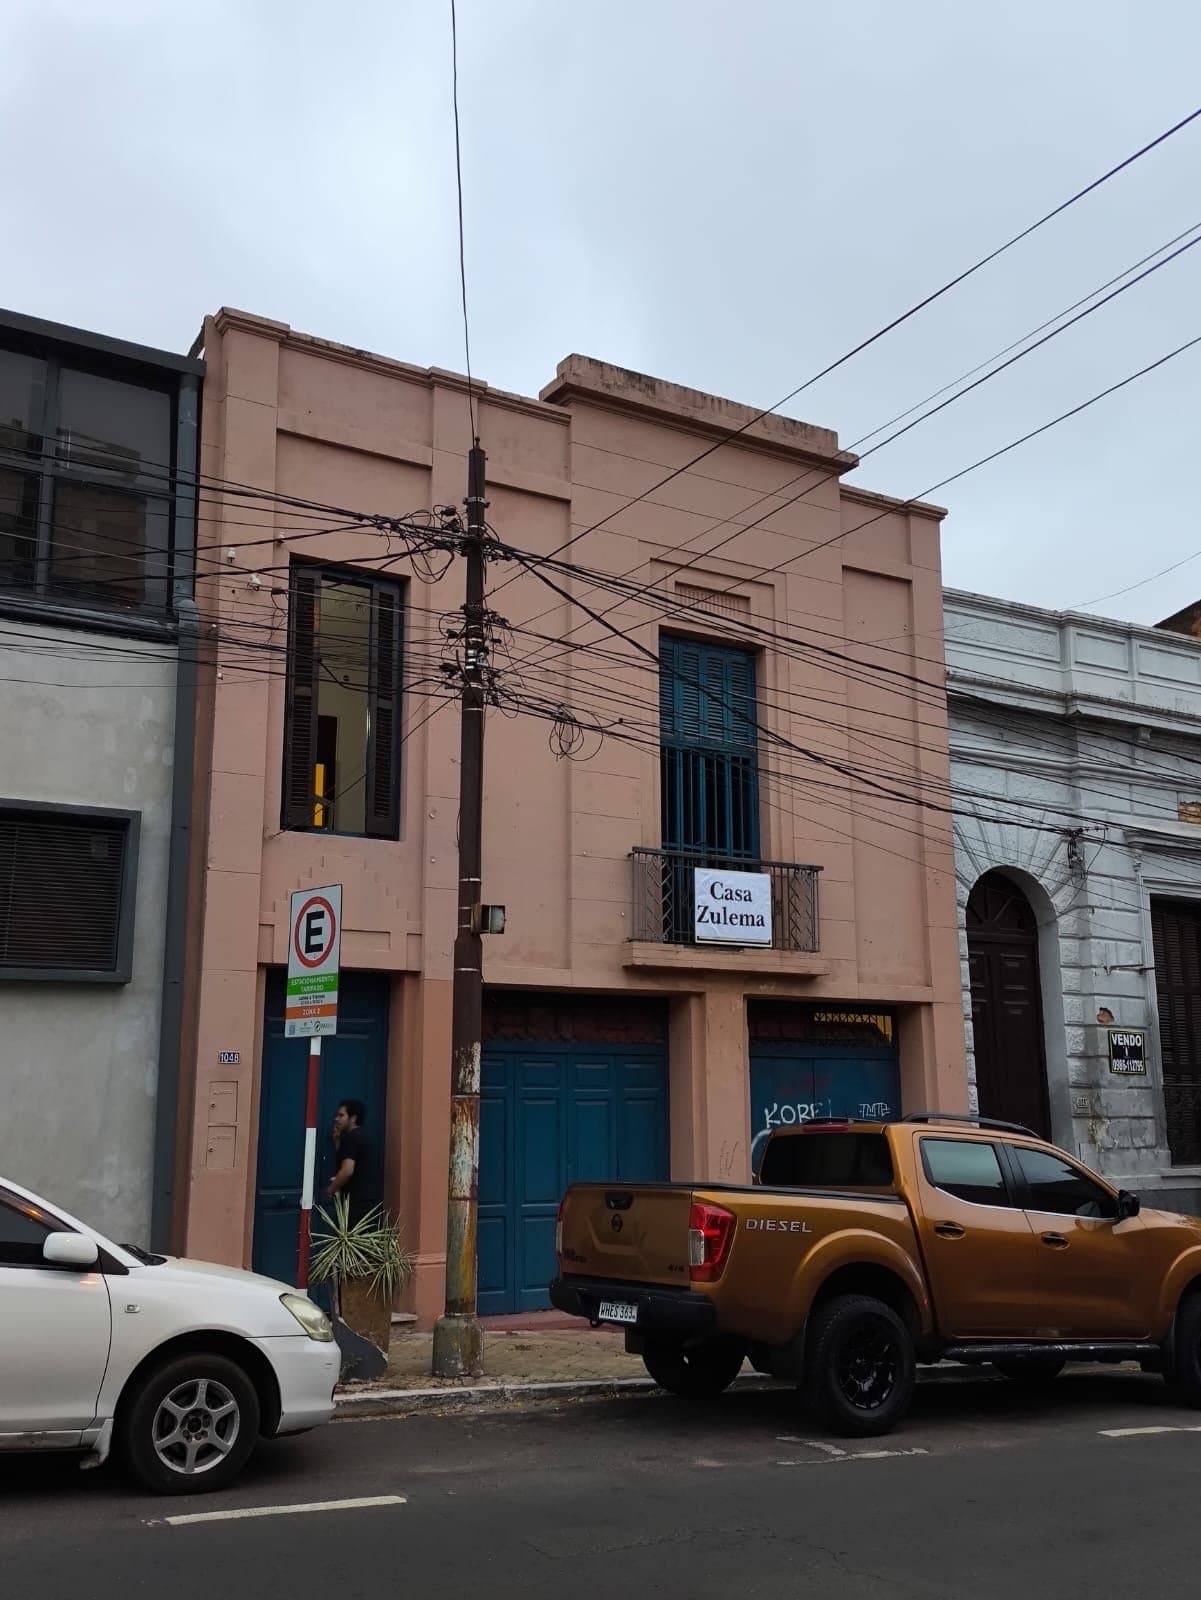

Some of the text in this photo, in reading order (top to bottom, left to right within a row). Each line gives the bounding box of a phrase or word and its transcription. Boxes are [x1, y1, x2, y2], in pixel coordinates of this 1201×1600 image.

[710, 881, 752, 902] Casa
[697, 905, 765, 927] Zulema
[305, 910, 325, 954] E
[1111, 1033, 1142, 1047] VENDO
[220, 1053, 239, 1062] 1048
[745, 1218, 813, 1233] DIESEL
